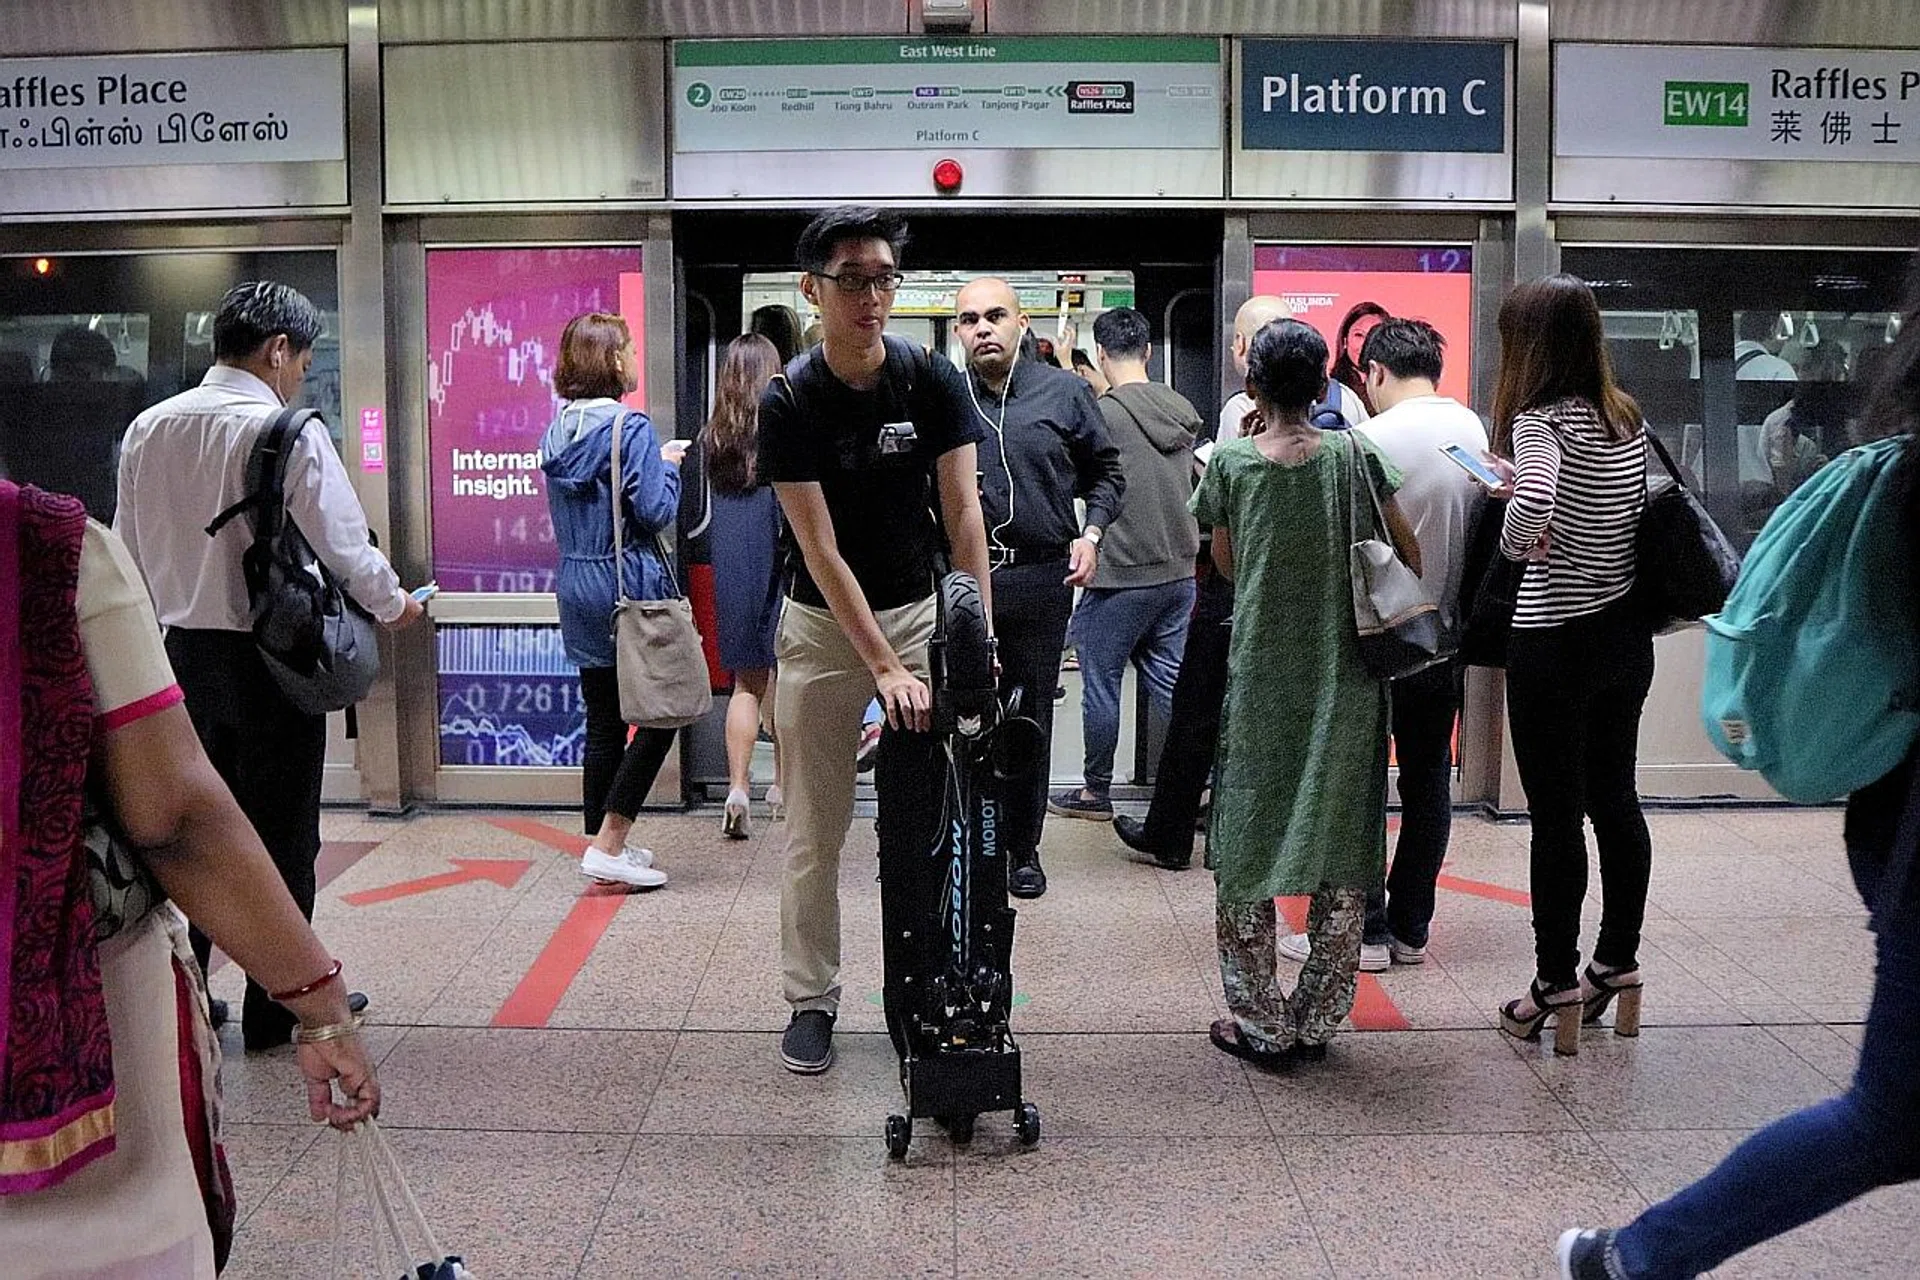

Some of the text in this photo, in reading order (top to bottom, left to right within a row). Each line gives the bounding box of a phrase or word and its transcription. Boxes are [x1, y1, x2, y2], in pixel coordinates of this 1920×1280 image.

[900, 44, 996, 58] East West Line
[98, 74, 187, 105] Place
[694, 87, 706, 103] 2
[1262, 73, 1487, 116] Platform C
[1770, 67, 1920, 100] Raffles P
[710, 103, 757, 113] Joo Koon
[781, 102, 815, 111] Redhill
[834, 101, 893, 113] Tiong Bahru
[907, 100, 969, 110] Outram Park
[981, 100, 1050, 112] Tanjong Pagar
[1070, 99, 1132, 110] Raffles Place
[1666, 90, 1747, 118] EW14
[157, 111, 288, 145] பிளேஸ்
[915, 129, 980, 142] Platform C
[1770, 109, 1902, 146] 莱佛士
[452, 448, 543, 471] Internat
[452, 474, 539, 499] insight.
[981, 795, 997, 858] MOBOT
[951, 818, 964, 964] MOBOT
